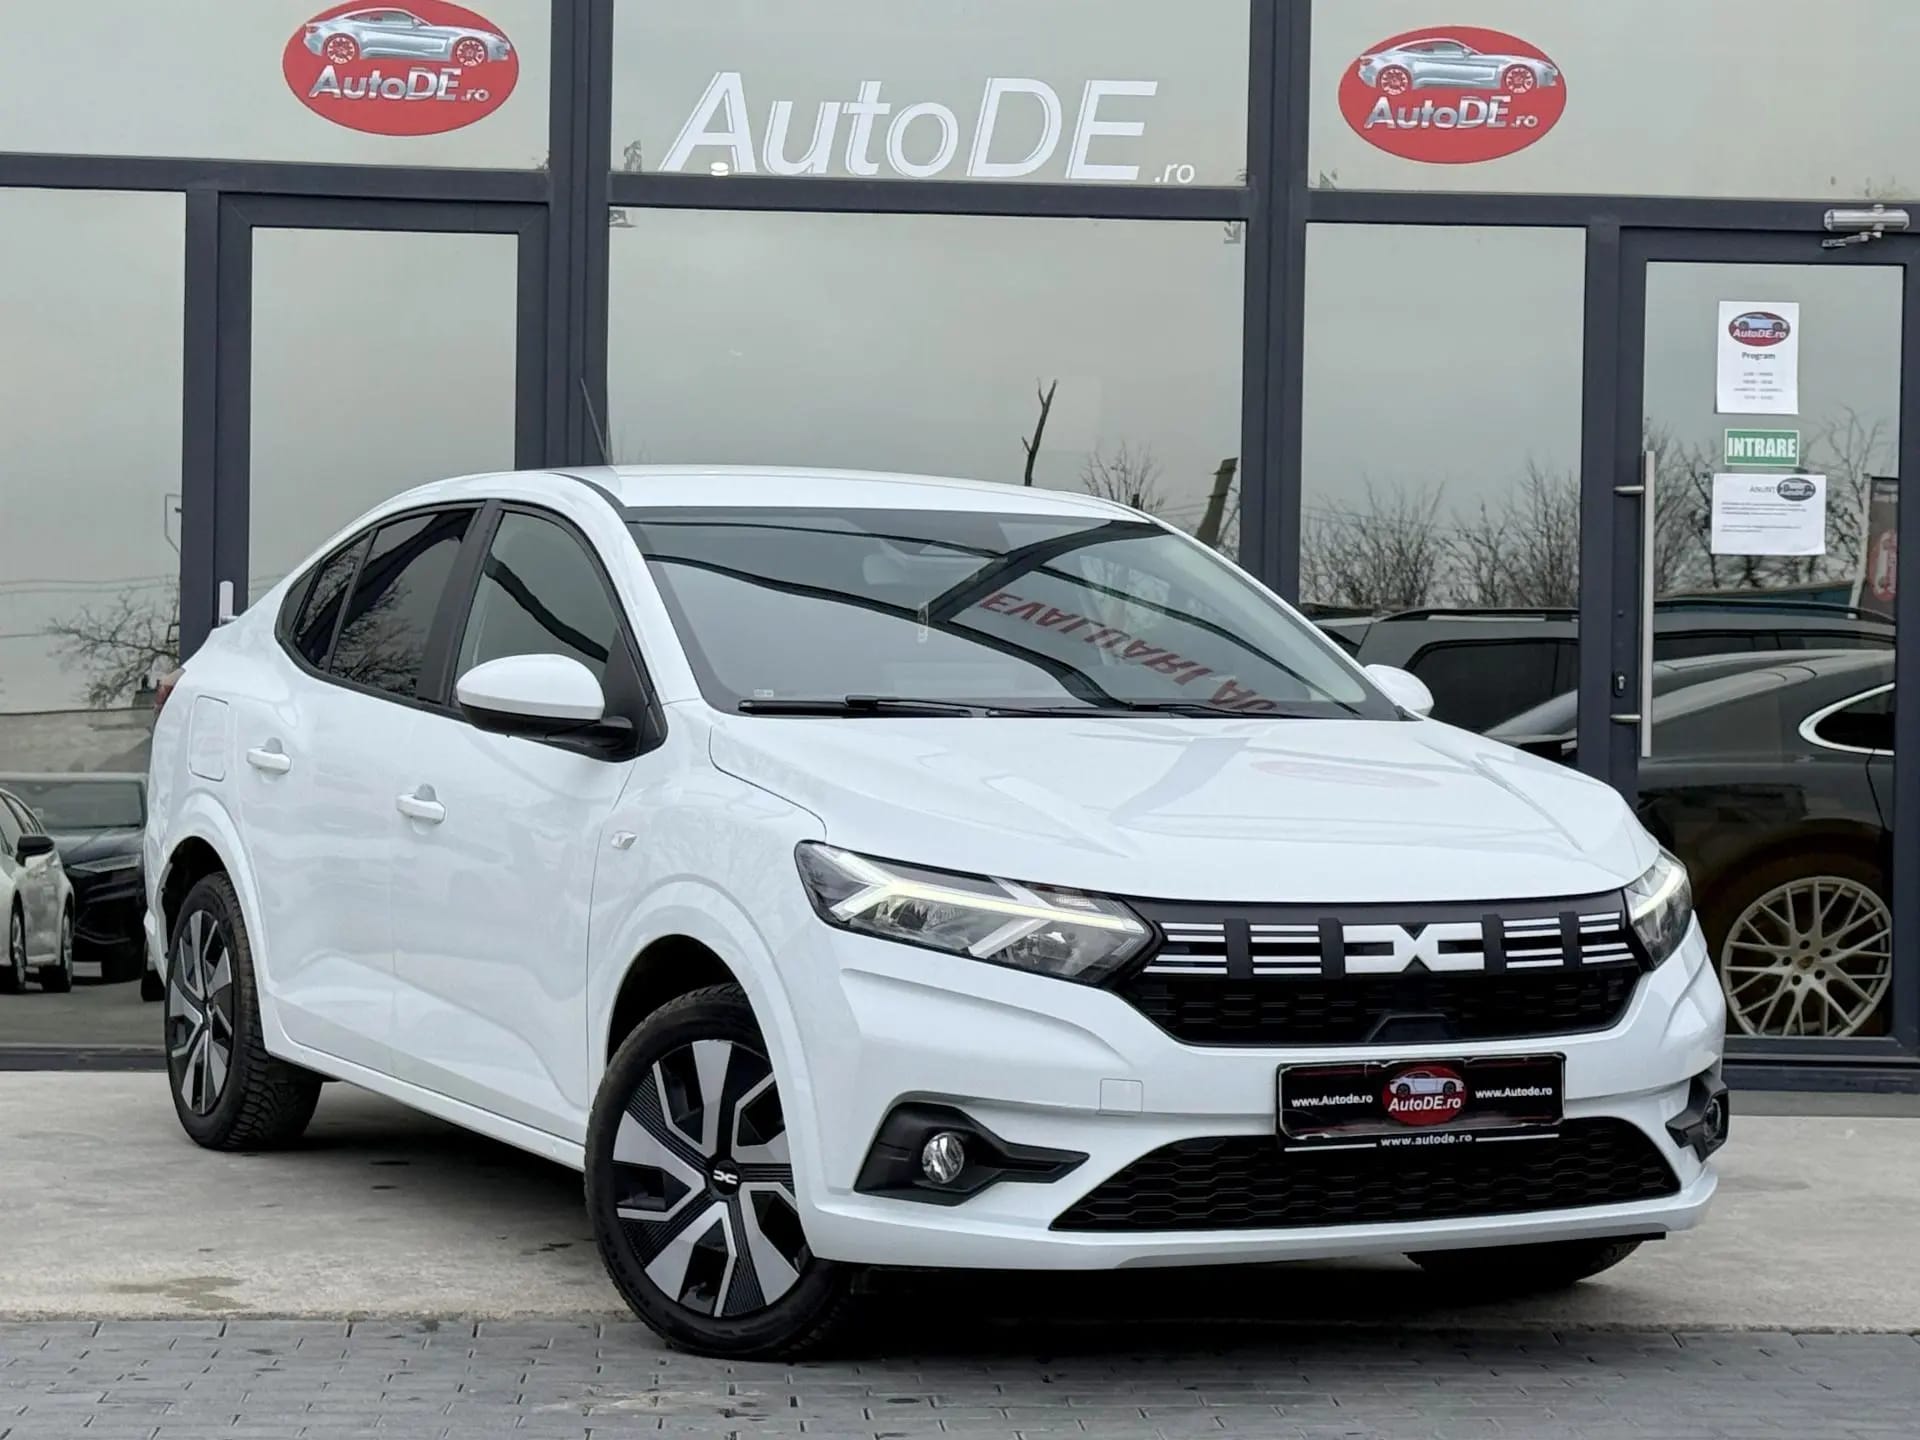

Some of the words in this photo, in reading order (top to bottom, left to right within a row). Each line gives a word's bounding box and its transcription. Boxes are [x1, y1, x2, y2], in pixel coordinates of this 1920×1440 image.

[1732, 328, 1787, 339] AutoDE.ro
[1741, 351, 1776, 361] Program
[1727, 437, 1796, 458] INTRARE
[1474, 1086, 1553, 1099] www.Autode.ro
[1291, 1094, 1374, 1108] www.Autode.ro
[1387, 1095, 1462, 1113] AutoDE.ro
[1380, 1132, 1473, 1147] www.autode.ro
